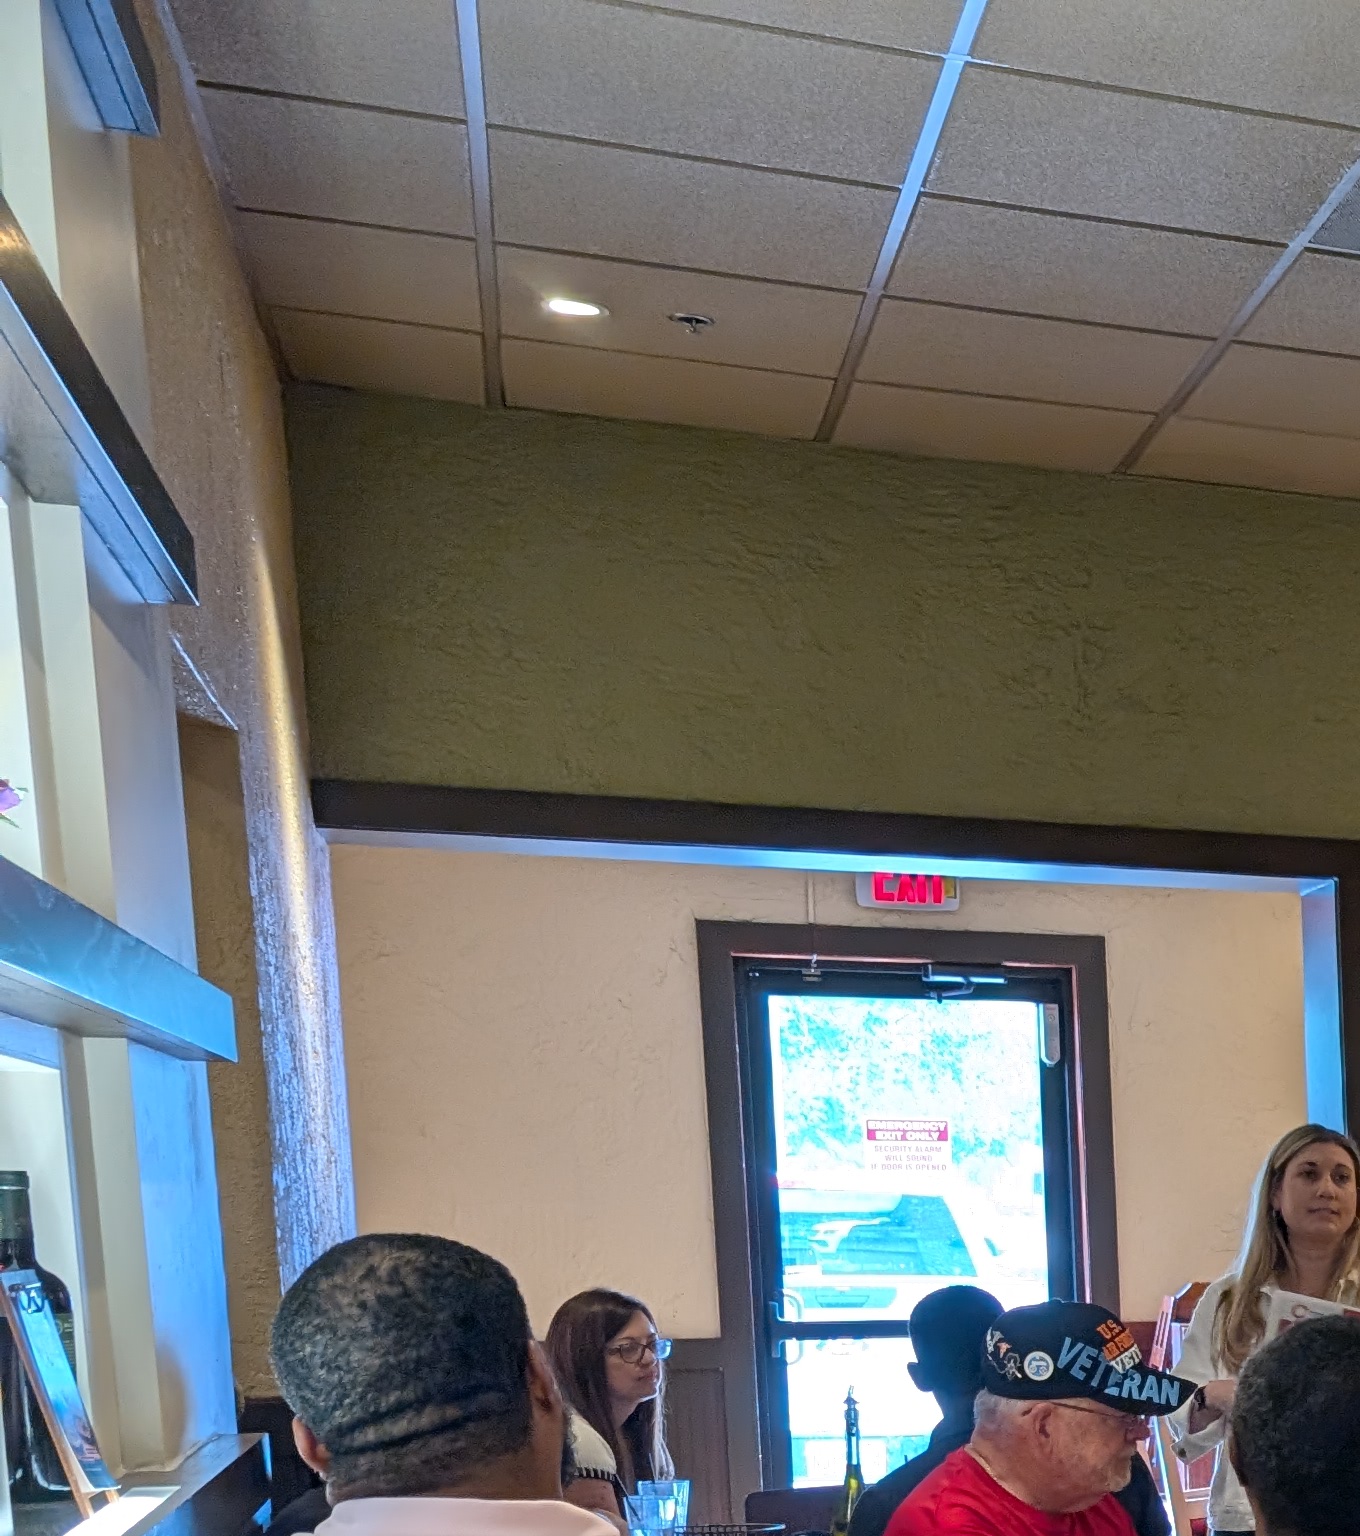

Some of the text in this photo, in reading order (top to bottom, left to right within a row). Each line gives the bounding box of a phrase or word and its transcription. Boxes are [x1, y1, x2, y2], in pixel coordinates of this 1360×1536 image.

[867, 1120, 946, 1132] EMERGENCY
[875, 1130, 941, 1141] EXIT ONLY
[874, 1145, 942, 1153] SECURITY ALARM
[884, 1154, 933, 1162] WILL SOUND
[881, 1163, 903, 1171] DOOR
[905, 1163, 913, 1171] IS
[915, 1163, 947, 1171] OPENED
[1056, 1336, 1181, 1407] VETERAN
